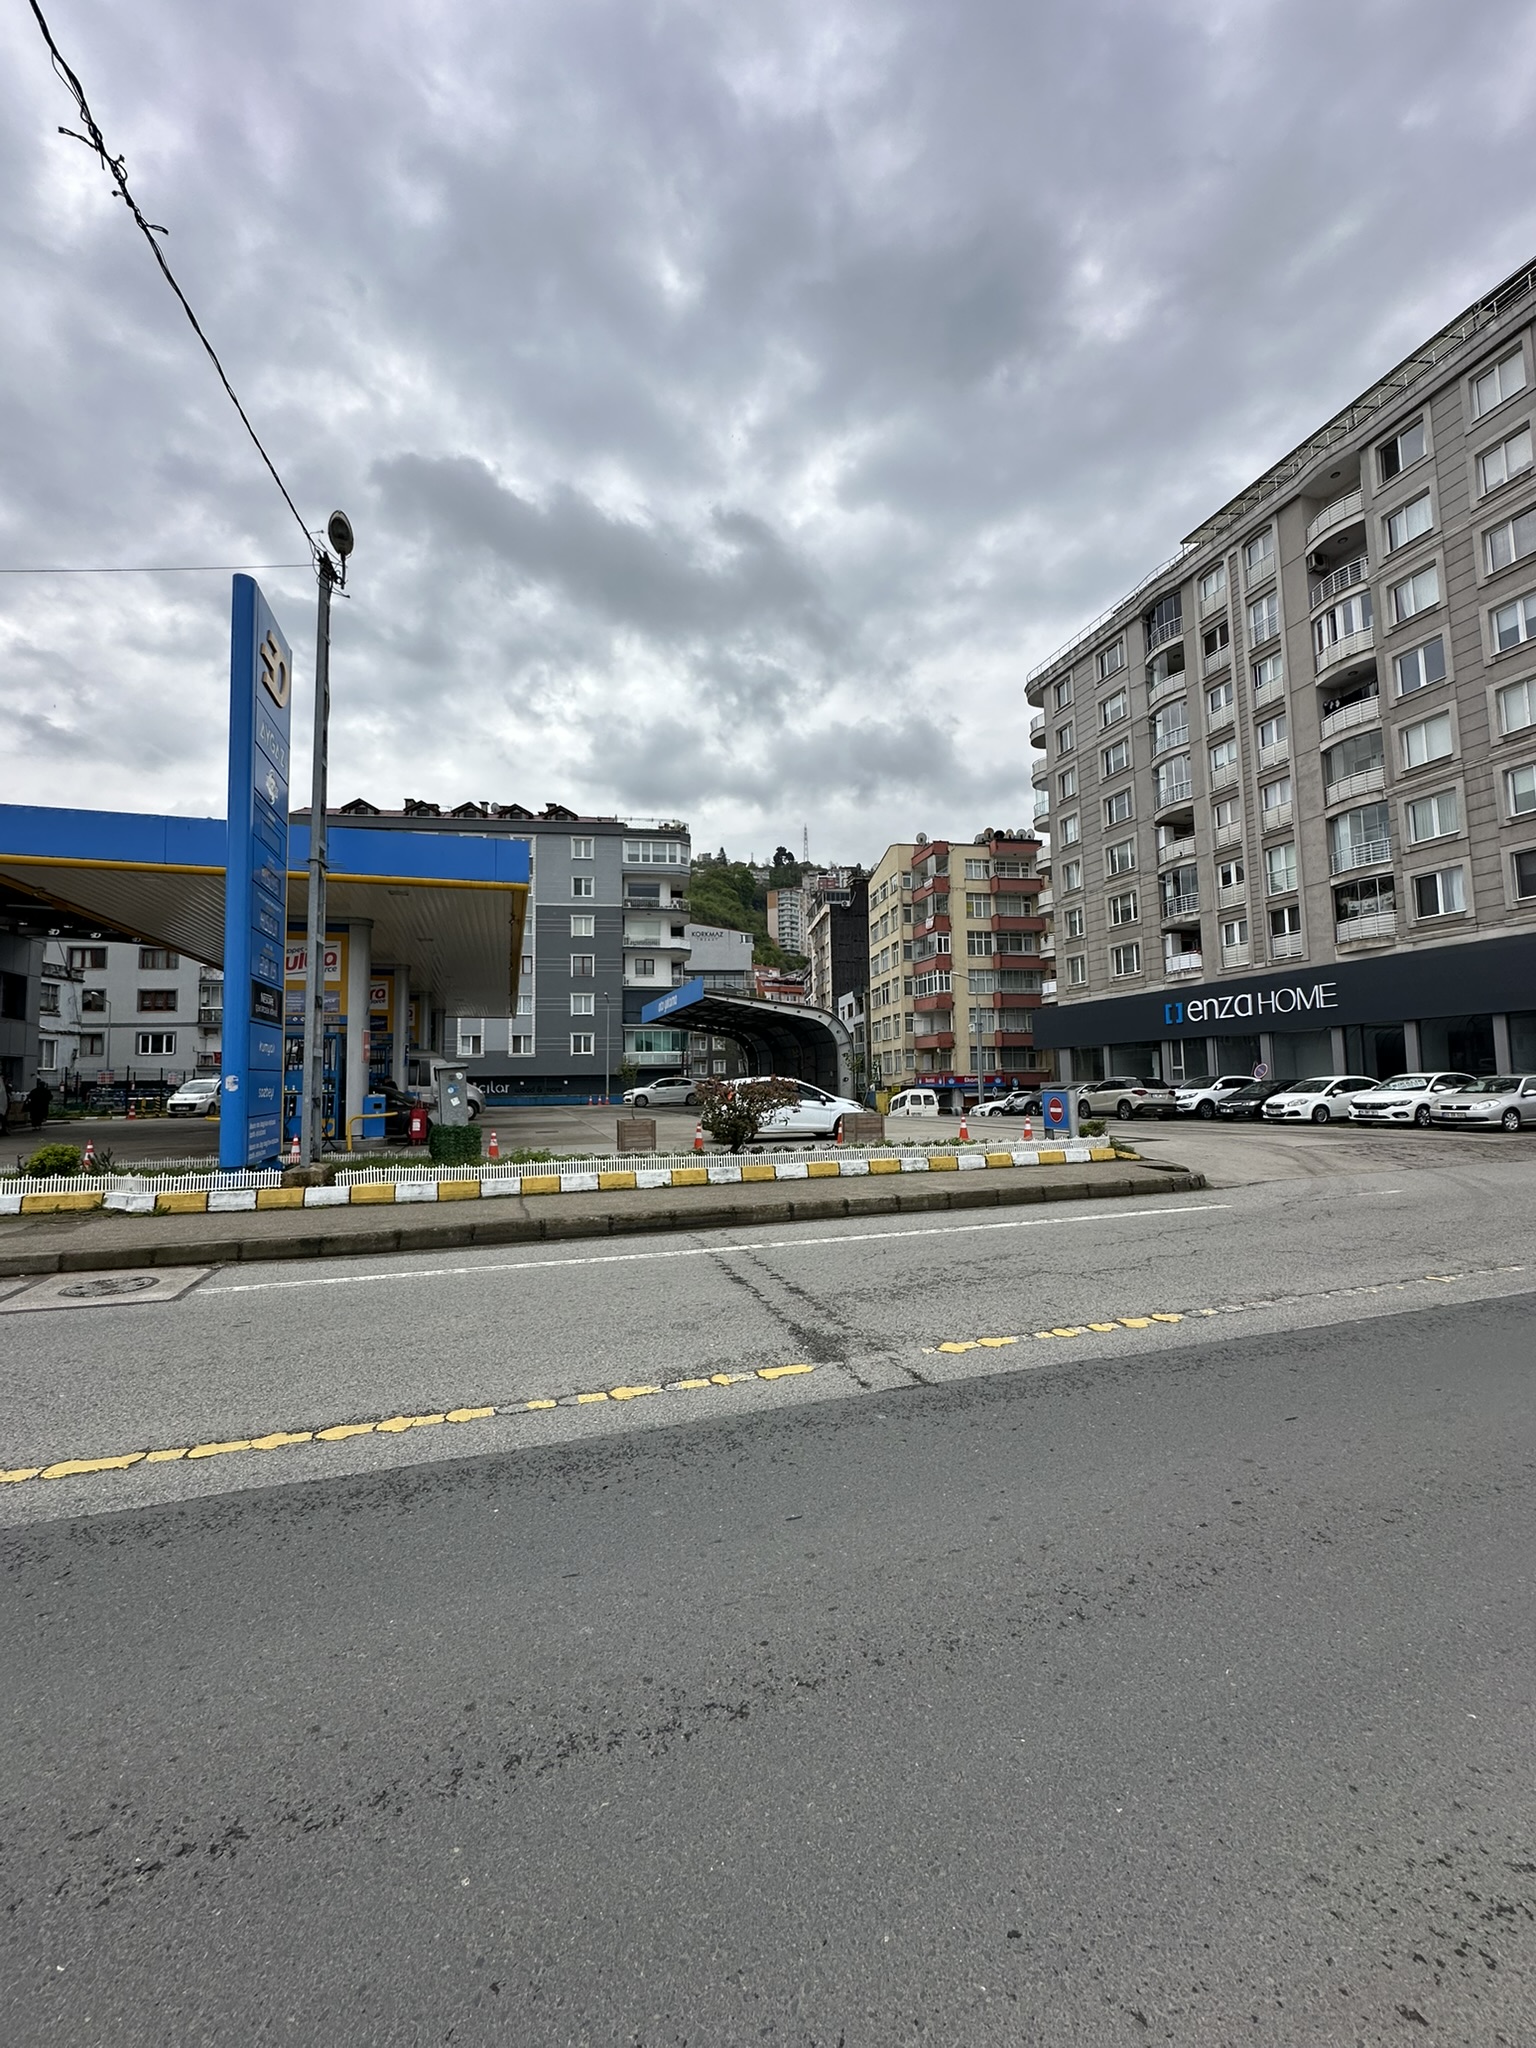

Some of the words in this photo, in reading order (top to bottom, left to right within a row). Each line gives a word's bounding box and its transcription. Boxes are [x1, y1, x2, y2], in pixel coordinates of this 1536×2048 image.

[260, 722, 285, 768] AYGAZ
[1187, 993, 1253, 1022] enza
[1257, 982, 1338, 1015] HOME
